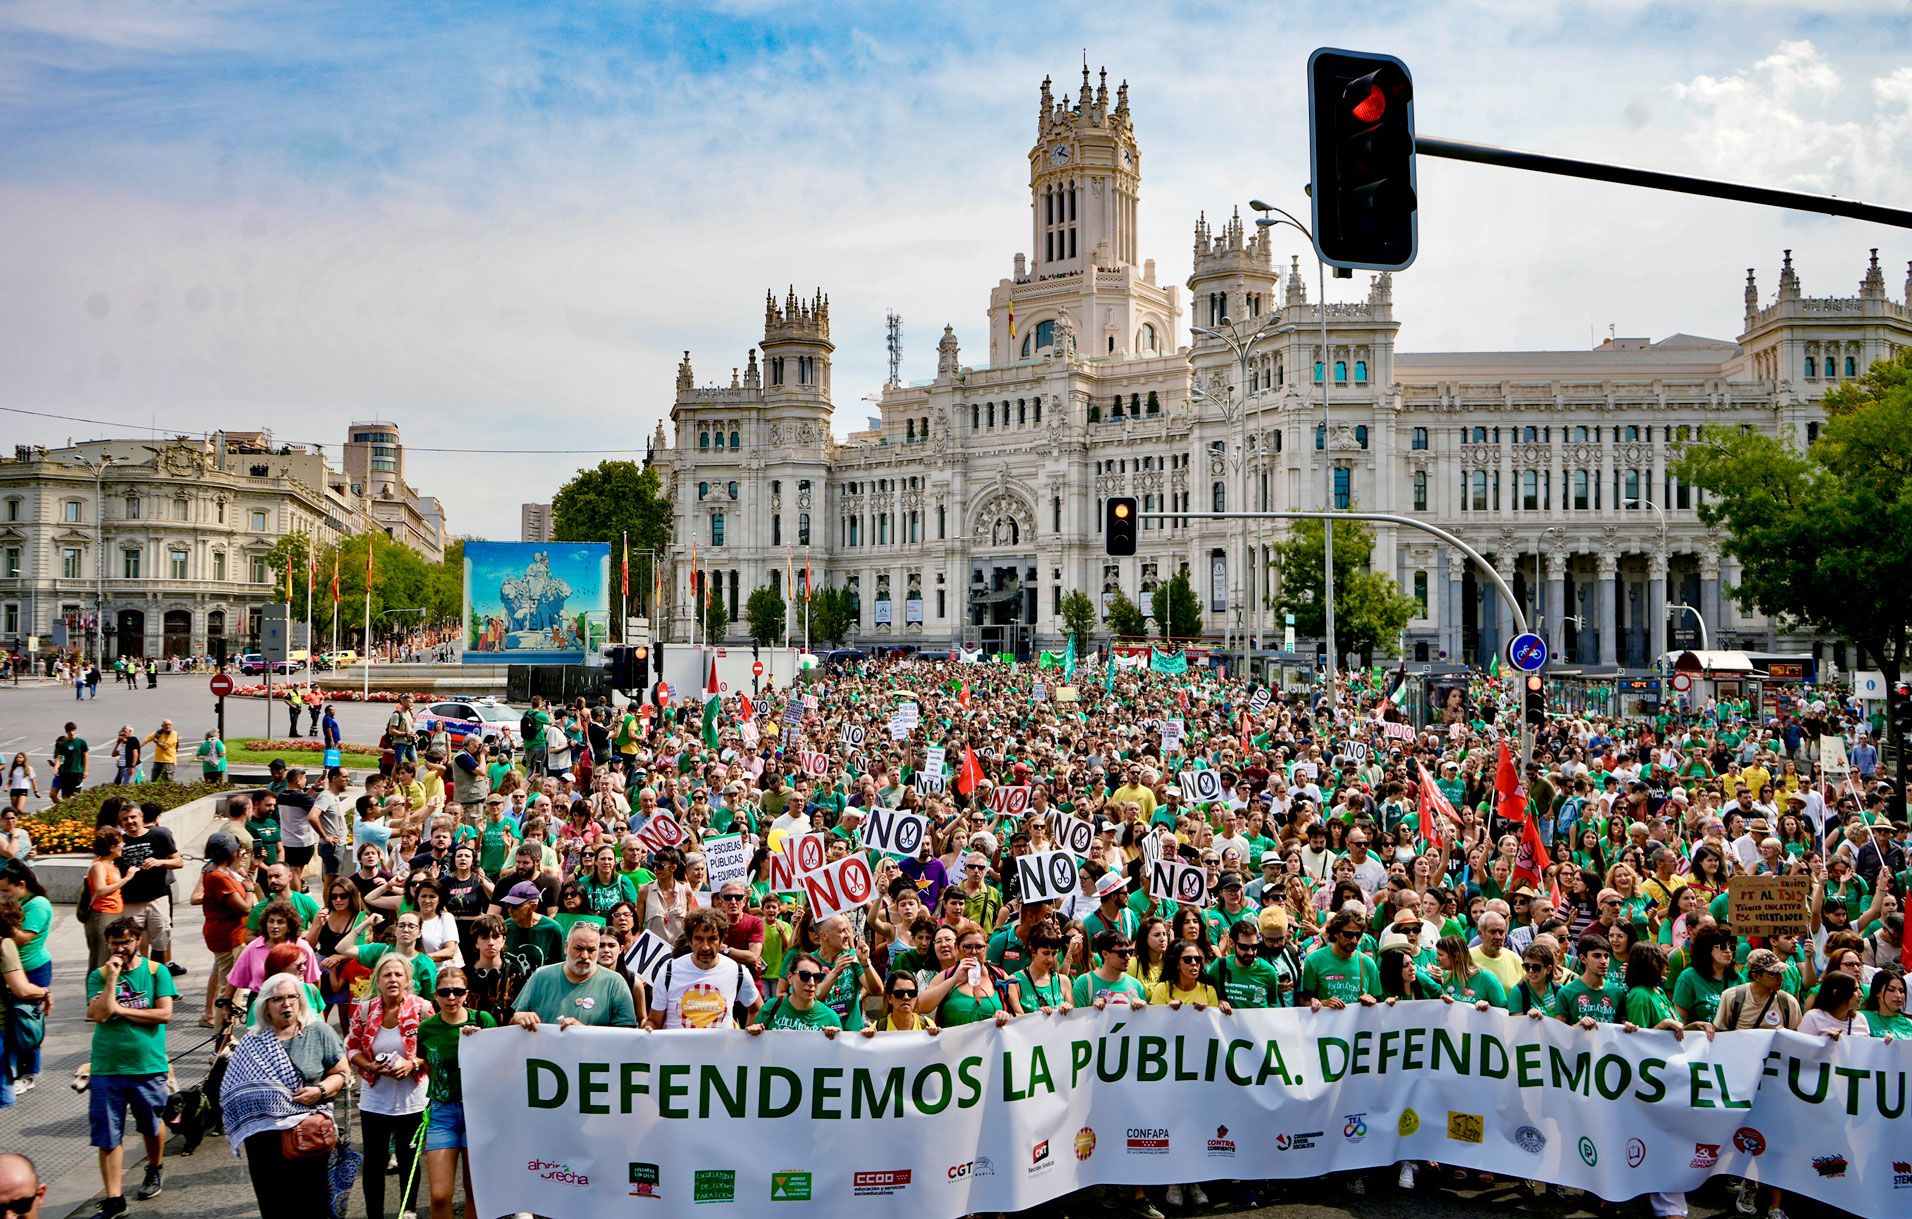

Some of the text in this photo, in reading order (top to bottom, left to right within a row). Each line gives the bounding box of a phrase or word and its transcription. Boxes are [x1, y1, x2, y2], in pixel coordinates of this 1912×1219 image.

[801, 695, 817, 707] NO
[1252, 688, 1270, 711] NO
[842, 726, 864, 743] NO
[1385, 724, 1401, 736] NO
[1346, 741, 1366, 759] NO
[801, 752, 828, 776] NO
[855, 756, 867, 772] N
[1182, 770, 1218, 799] NO
[990, 788, 1029, 815] NO
[637, 814, 682, 854] NO
[865, 808, 922, 853] NO
[1054, 813, 1092, 853] NO
[714, 841, 742, 854] ESCUELAS
[780, 835, 824, 875] NO
[1145, 832, 1160, 868] NO
[710, 854, 744, 868] PÚBLICAS
[1019, 852, 1077, 900] NO
[1152, 860, 1205, 902] NO
[805, 857, 872, 919] NO
[1741, 891, 1755, 900] PT
[1760, 890, 1774, 900] AL
[405, 1028, 418, 1036] CGT
[526, 1056, 983, 1120] DEFENDEMOS
[1003, 1044, 1056, 1103] LA
[1071, 1022, 1303, 1089] PÚBLICA.
[1318, 1028, 1669, 1108] DEFENDEMOS
[1687, 1061, 1753, 1110] EL
[1127, 1128, 1169, 1138] CONFAPA
[1035, 1144, 1048, 1158] CNT
[1207, 1140, 1236, 1148] CONTRA
[857, 1173, 894, 1184] CCOO
[948, 1162, 974, 1179] CGT
